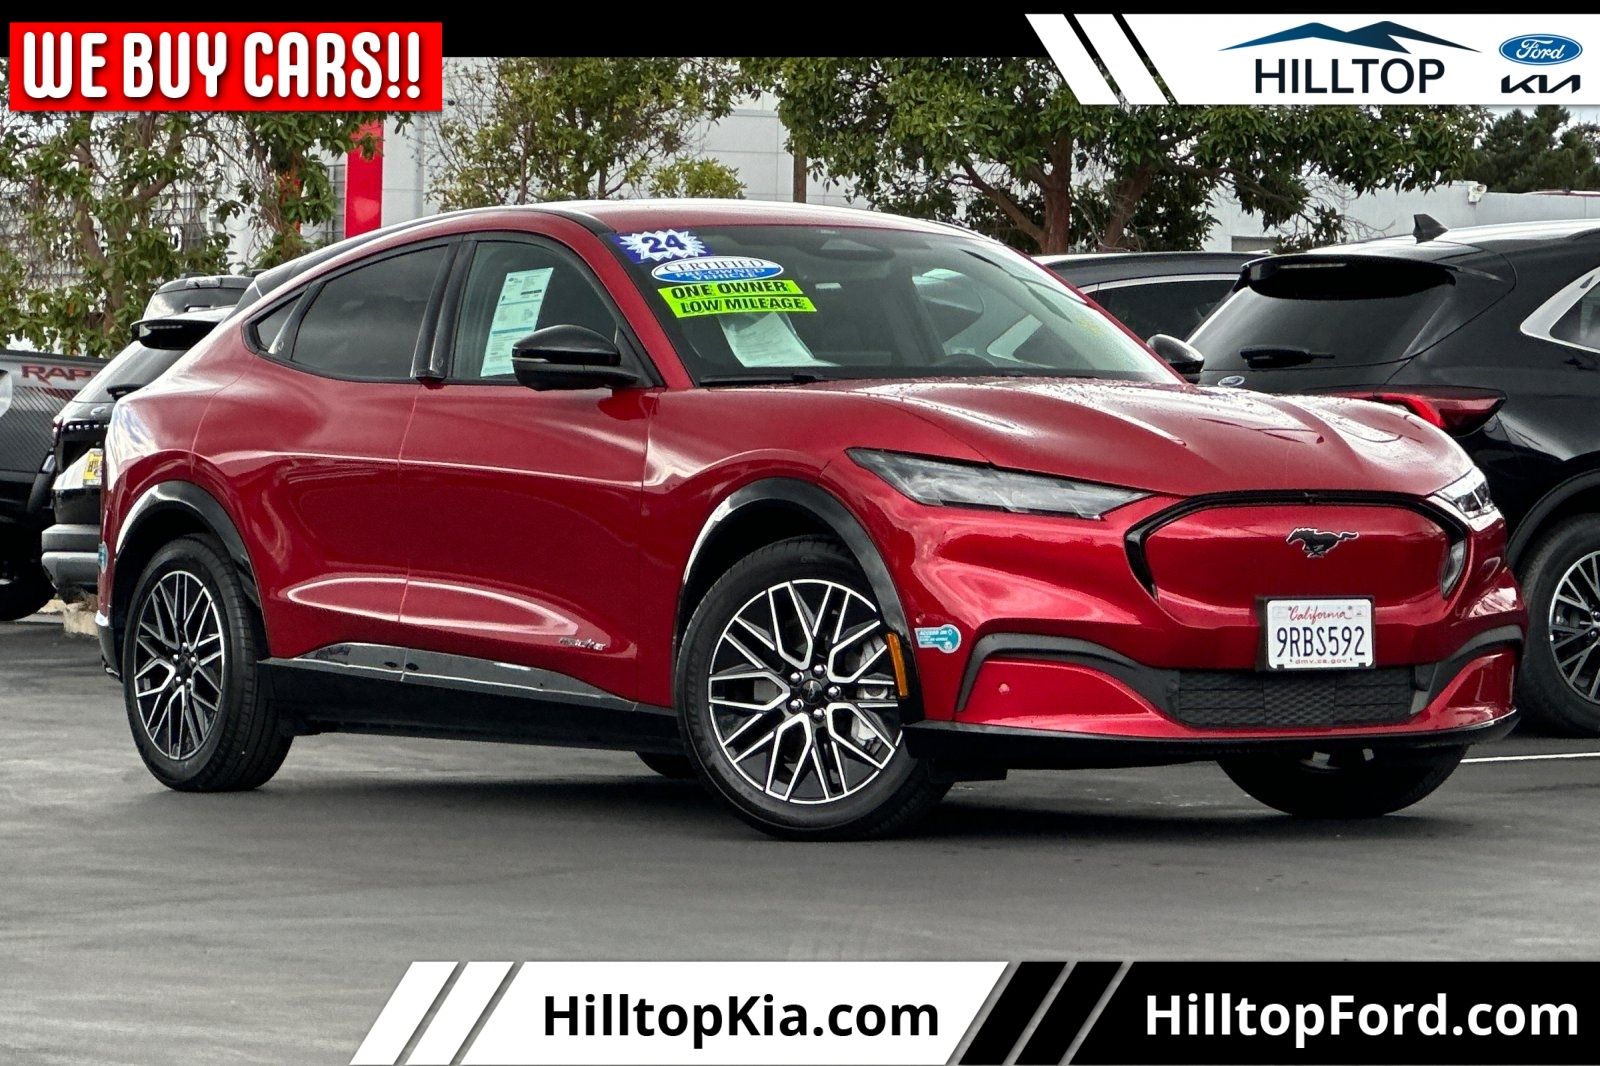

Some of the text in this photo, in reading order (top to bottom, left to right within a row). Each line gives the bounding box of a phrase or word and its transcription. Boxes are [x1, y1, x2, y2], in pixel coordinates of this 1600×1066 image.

[641, 234, 688, 254] 24
[664, 259, 765, 273] CERTIFIED
[671, 281, 788, 299] ONE OWNER
[681, 297, 805, 313] LOW MILEAGE
[22, 364, 95, 386] RAP
[1290, 605, 1352, 625] California
[1277, 626, 1365, 658] 9RBS592
